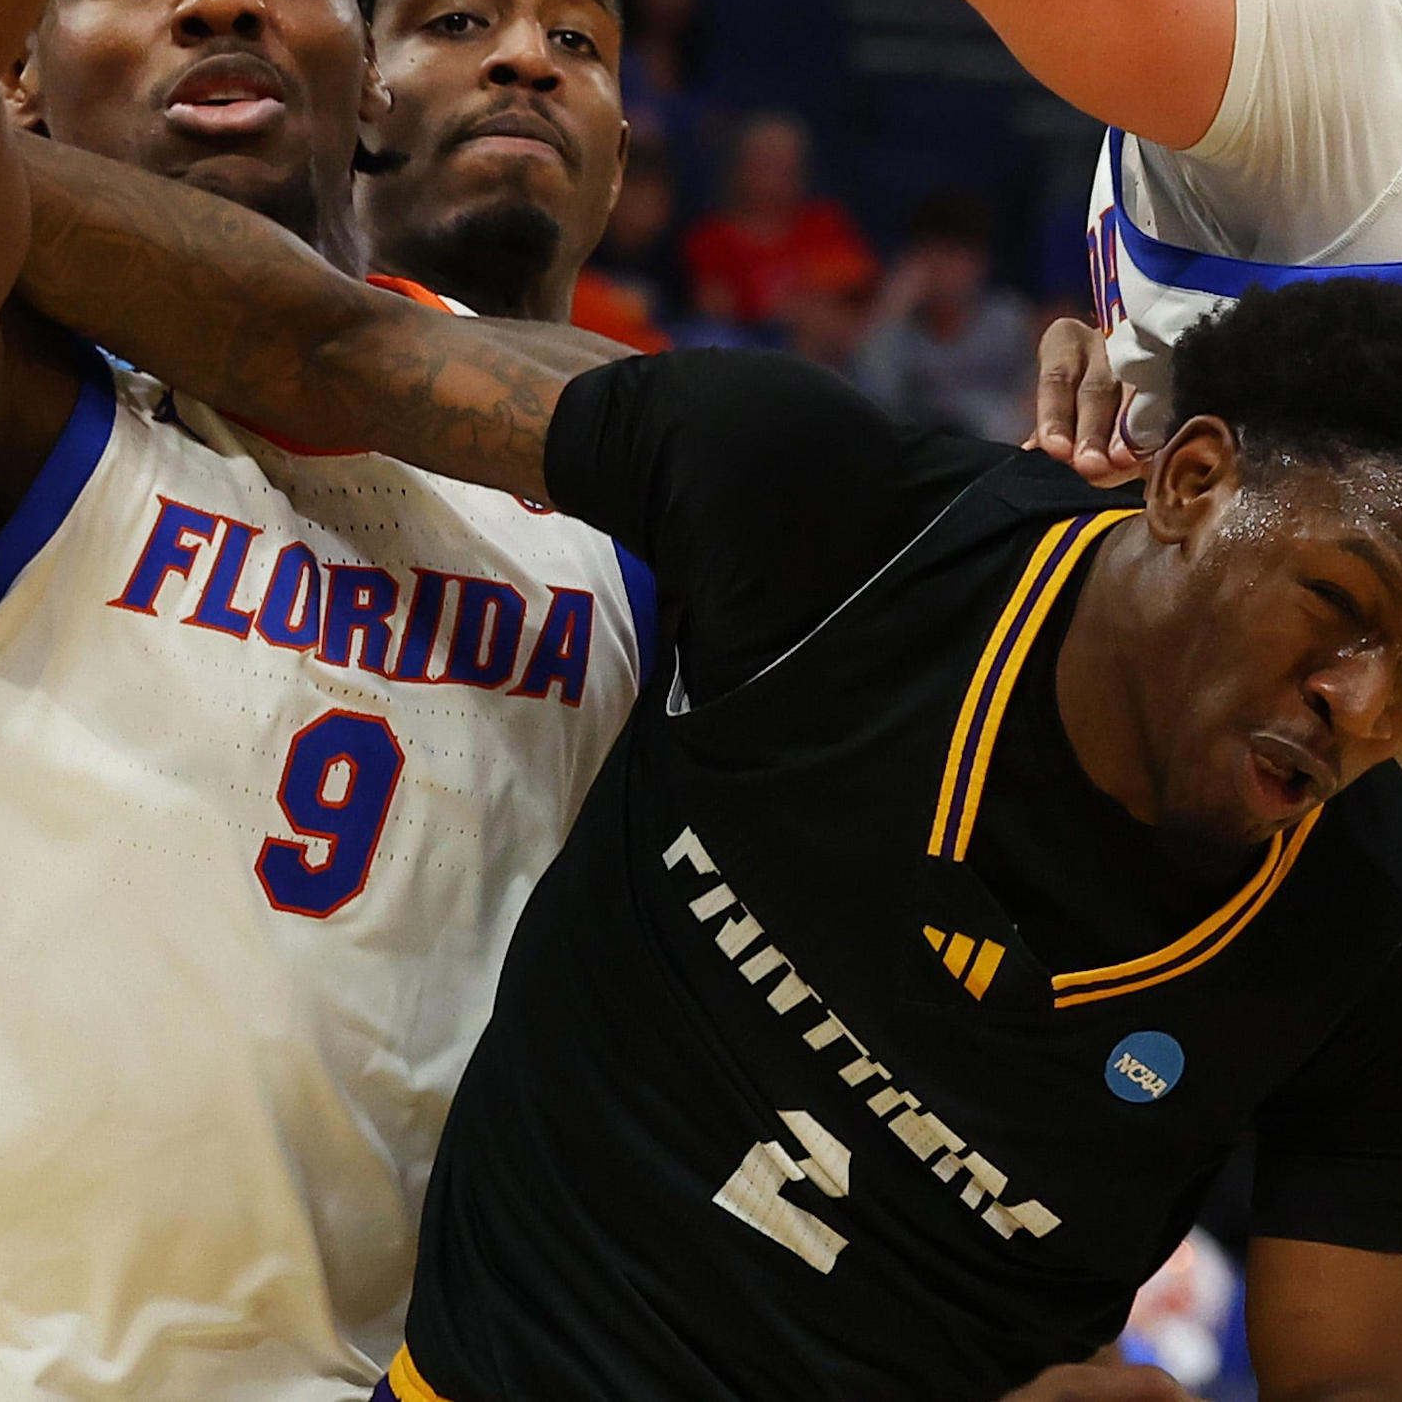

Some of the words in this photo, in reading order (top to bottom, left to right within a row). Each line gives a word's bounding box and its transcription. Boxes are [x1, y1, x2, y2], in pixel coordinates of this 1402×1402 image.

[106, 494, 595, 707] FLORIDA
[255, 708, 405, 919] 9
[1114, 1052, 1167, 1099] NCAA
[712, 1109, 852, 1275] 2
